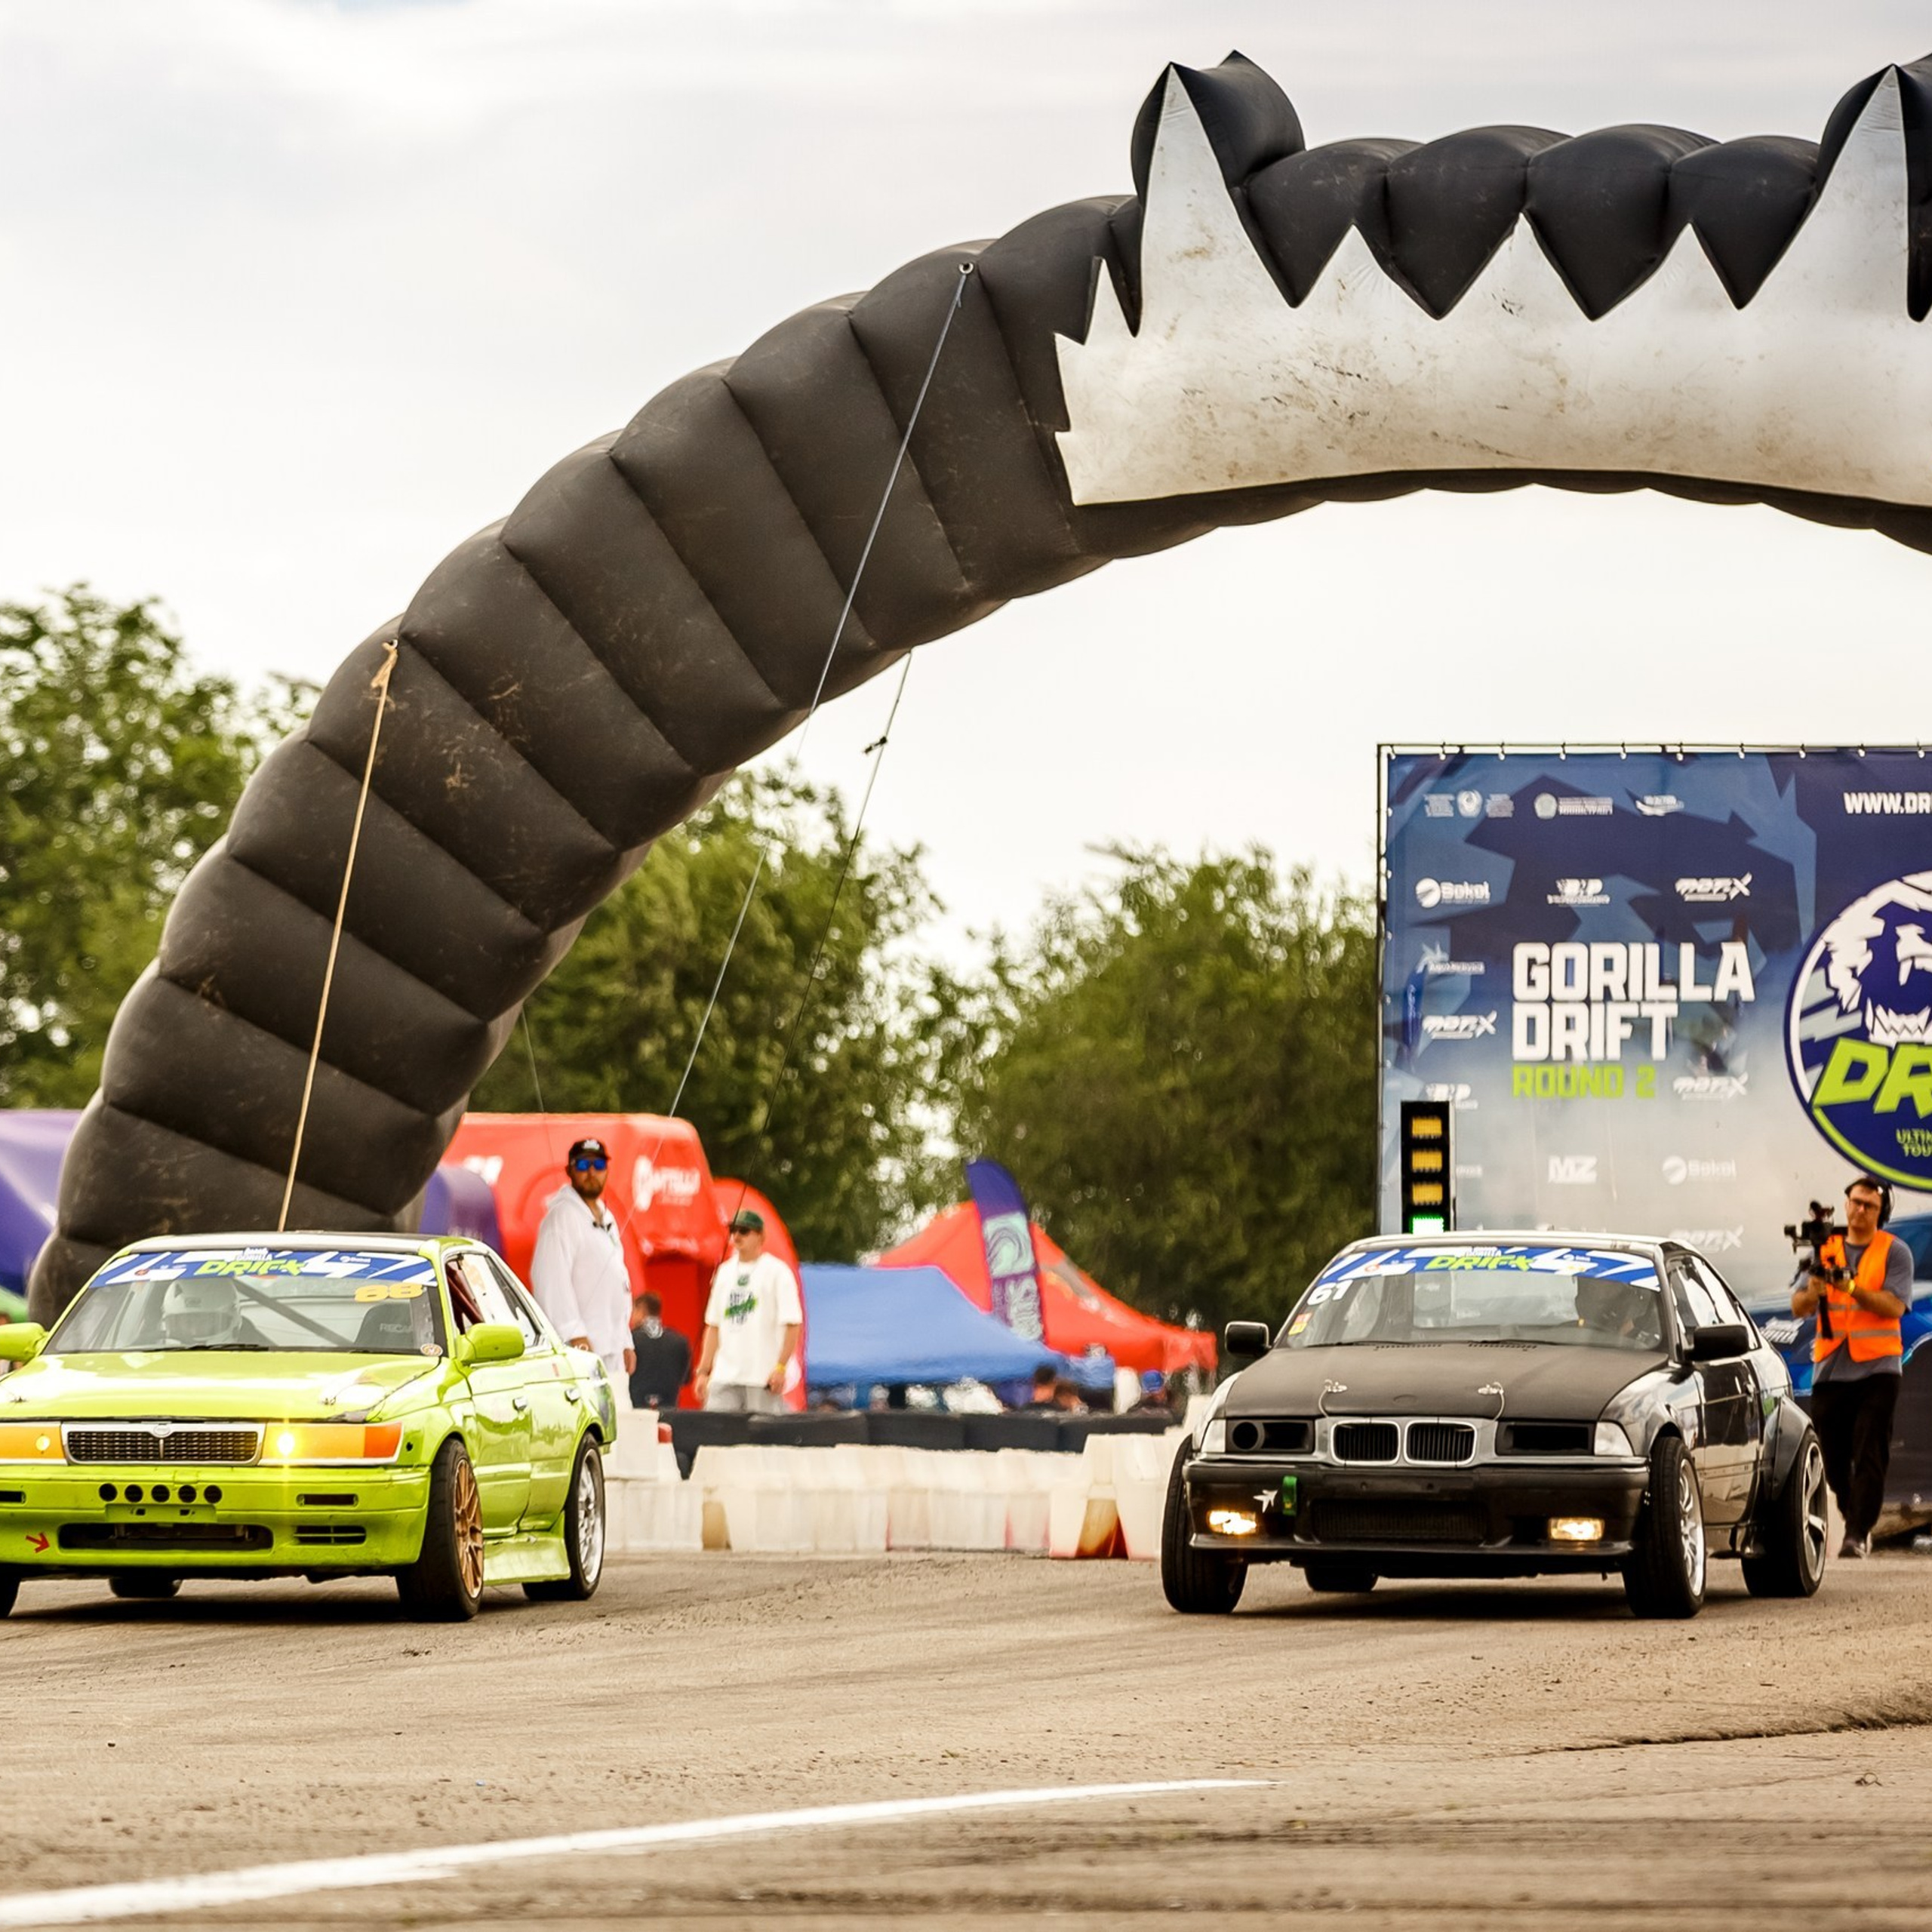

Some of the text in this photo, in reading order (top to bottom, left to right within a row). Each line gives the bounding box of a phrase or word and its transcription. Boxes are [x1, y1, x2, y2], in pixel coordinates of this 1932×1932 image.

[1843, 792, 1932, 814] WWW.DR
[1512, 942, 1755, 1001] GORILLA
[1512, 1001, 1678, 1061] DRIFT
[1512, 1064, 1623, 1099] ROUND
[1635, 1064, 1656, 1099] 2
[1307, 1279, 1354, 1306] 61
